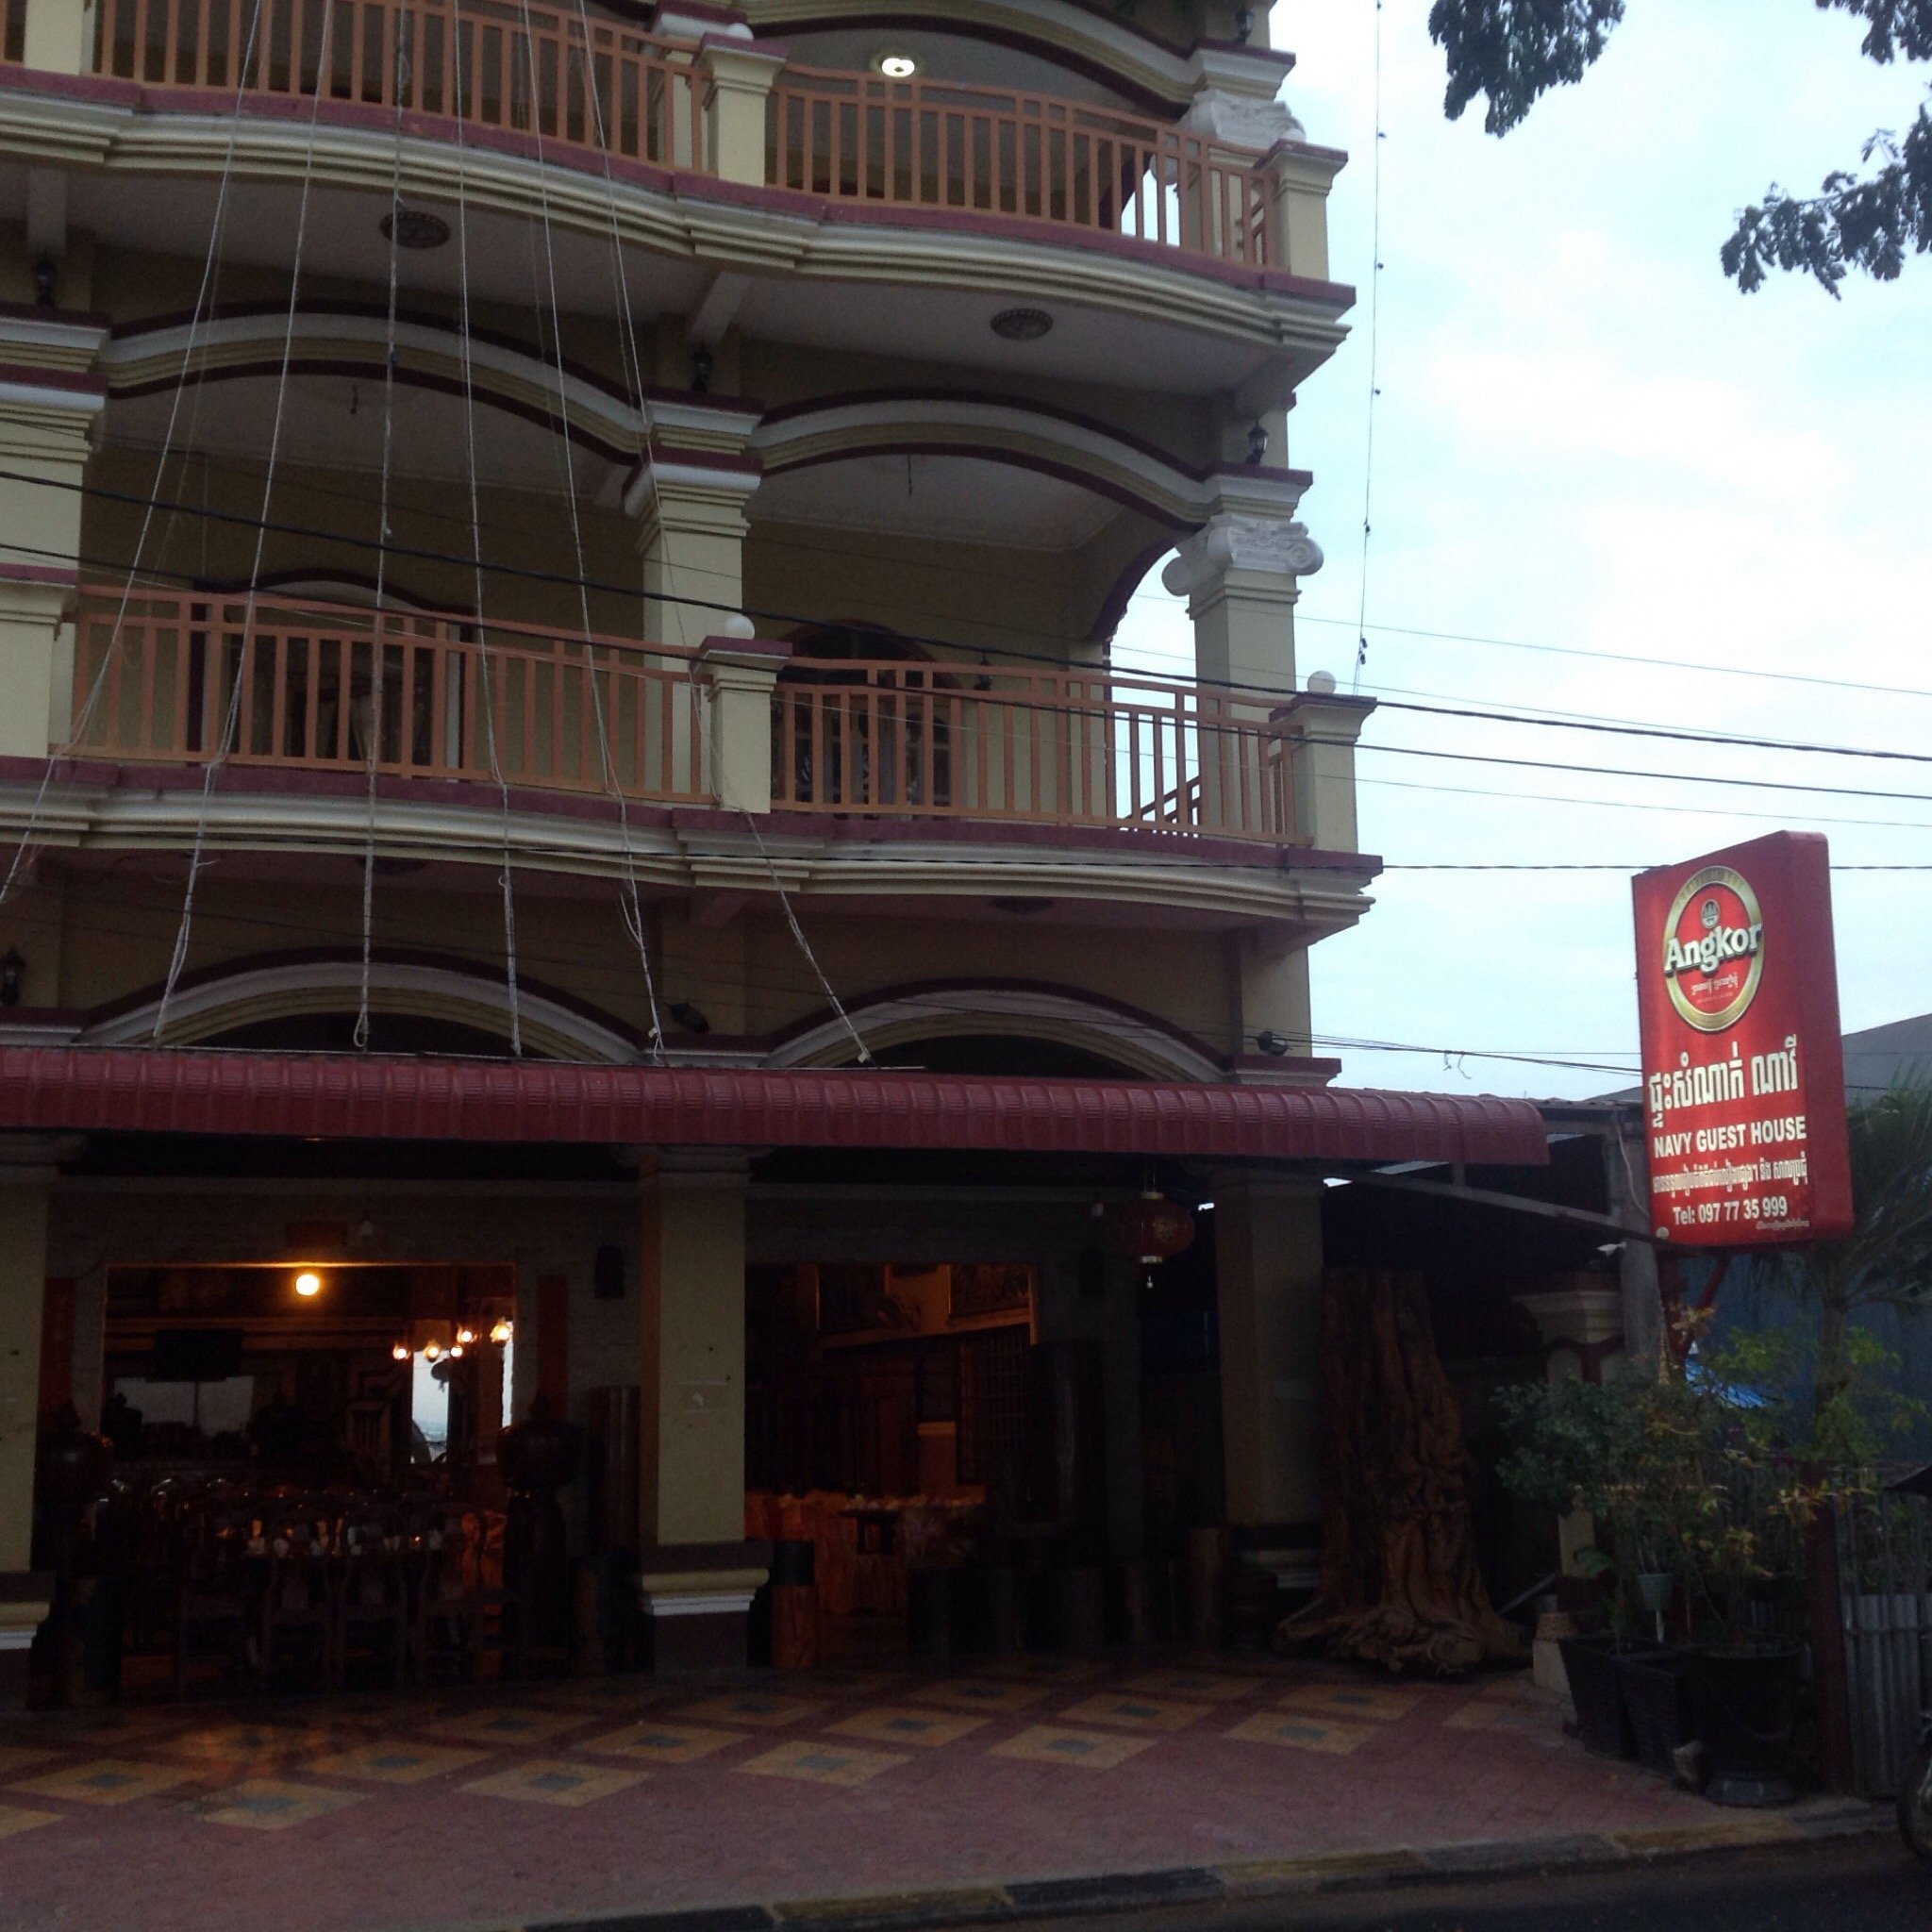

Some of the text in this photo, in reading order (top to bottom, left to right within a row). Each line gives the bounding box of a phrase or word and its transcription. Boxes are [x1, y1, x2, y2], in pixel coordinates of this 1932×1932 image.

[1664, 922, 1762, 974] Angkor
[1649, 1034, 1798, 1127] ផ្ទះសំណាក់ ណាវី
[1654, 1116, 1807, 1158] NAVY GUEST HOUSE
[1673, 1195, 1788, 1225] Tel: 097 77 35 999
